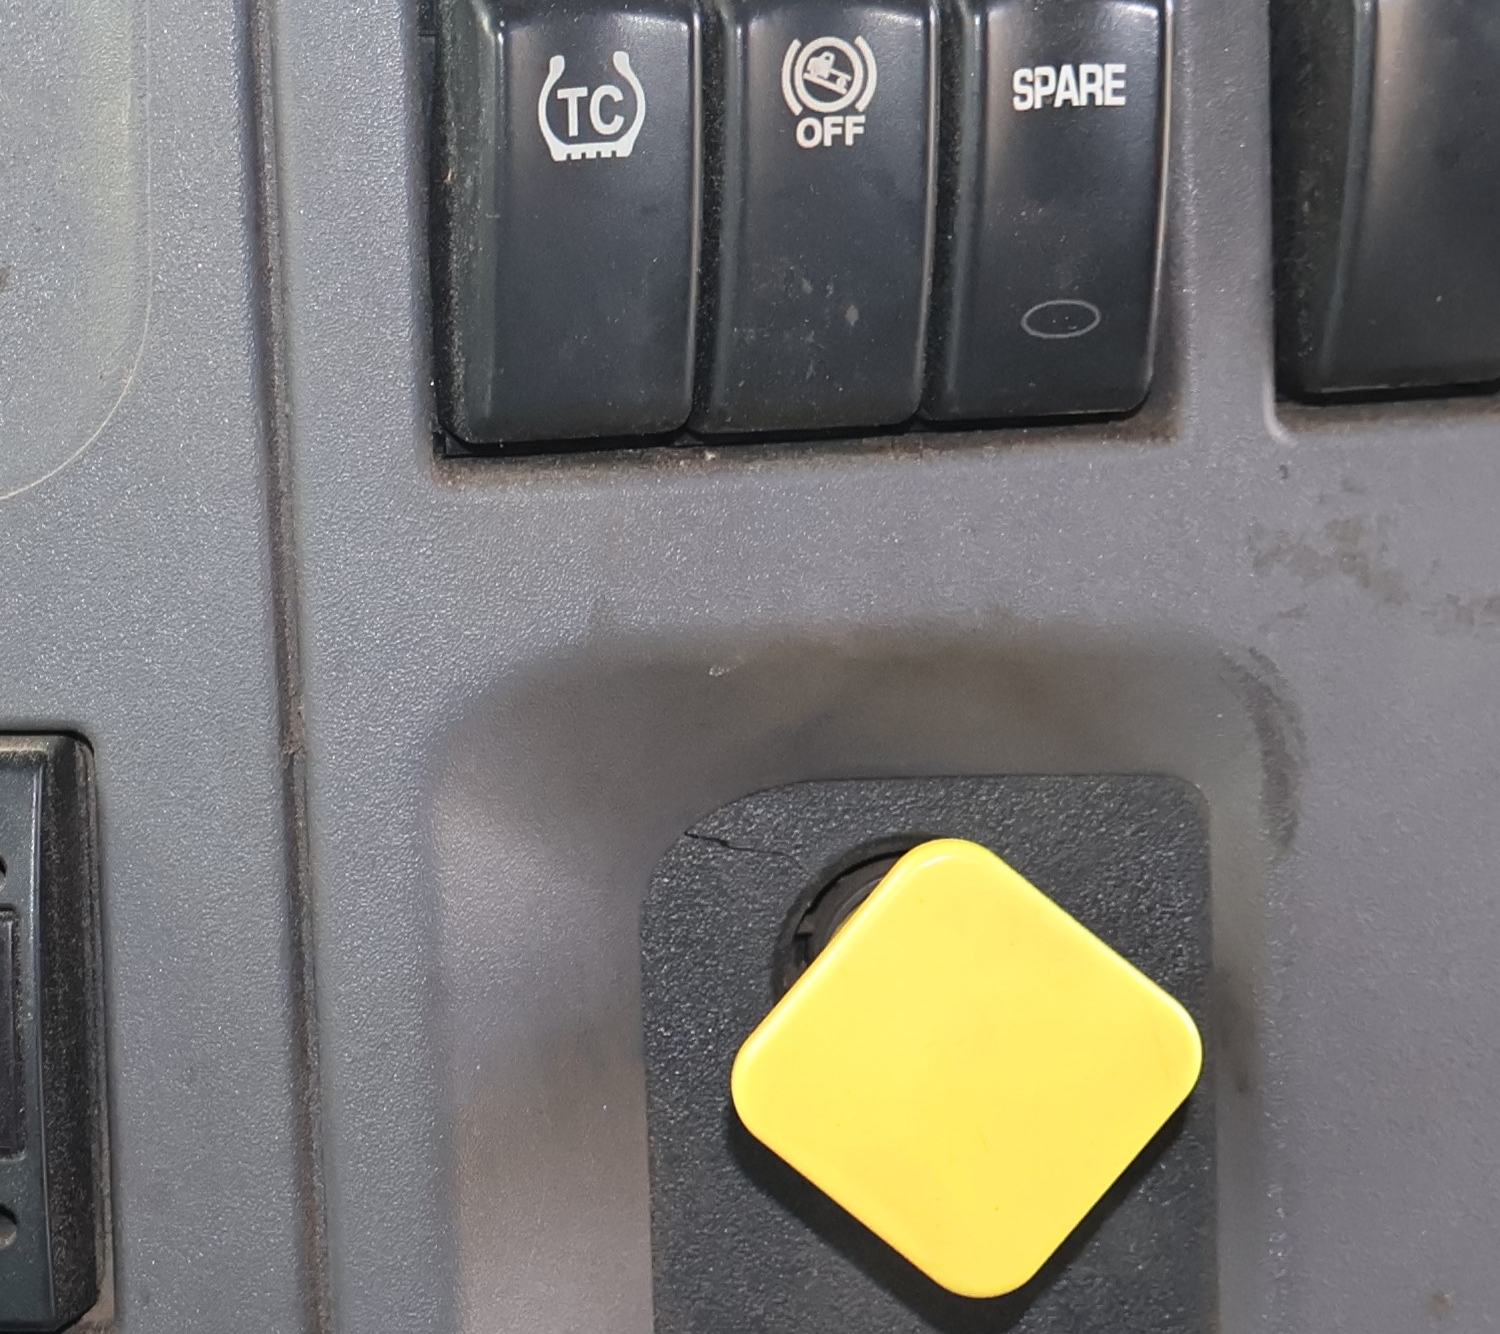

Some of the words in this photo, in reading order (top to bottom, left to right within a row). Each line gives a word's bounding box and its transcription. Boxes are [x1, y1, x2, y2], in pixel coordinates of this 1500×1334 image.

[557, 85, 625, 137] TC
[1012, 63, 1126, 112] SPARE
[796, 115, 866, 149] OFF
